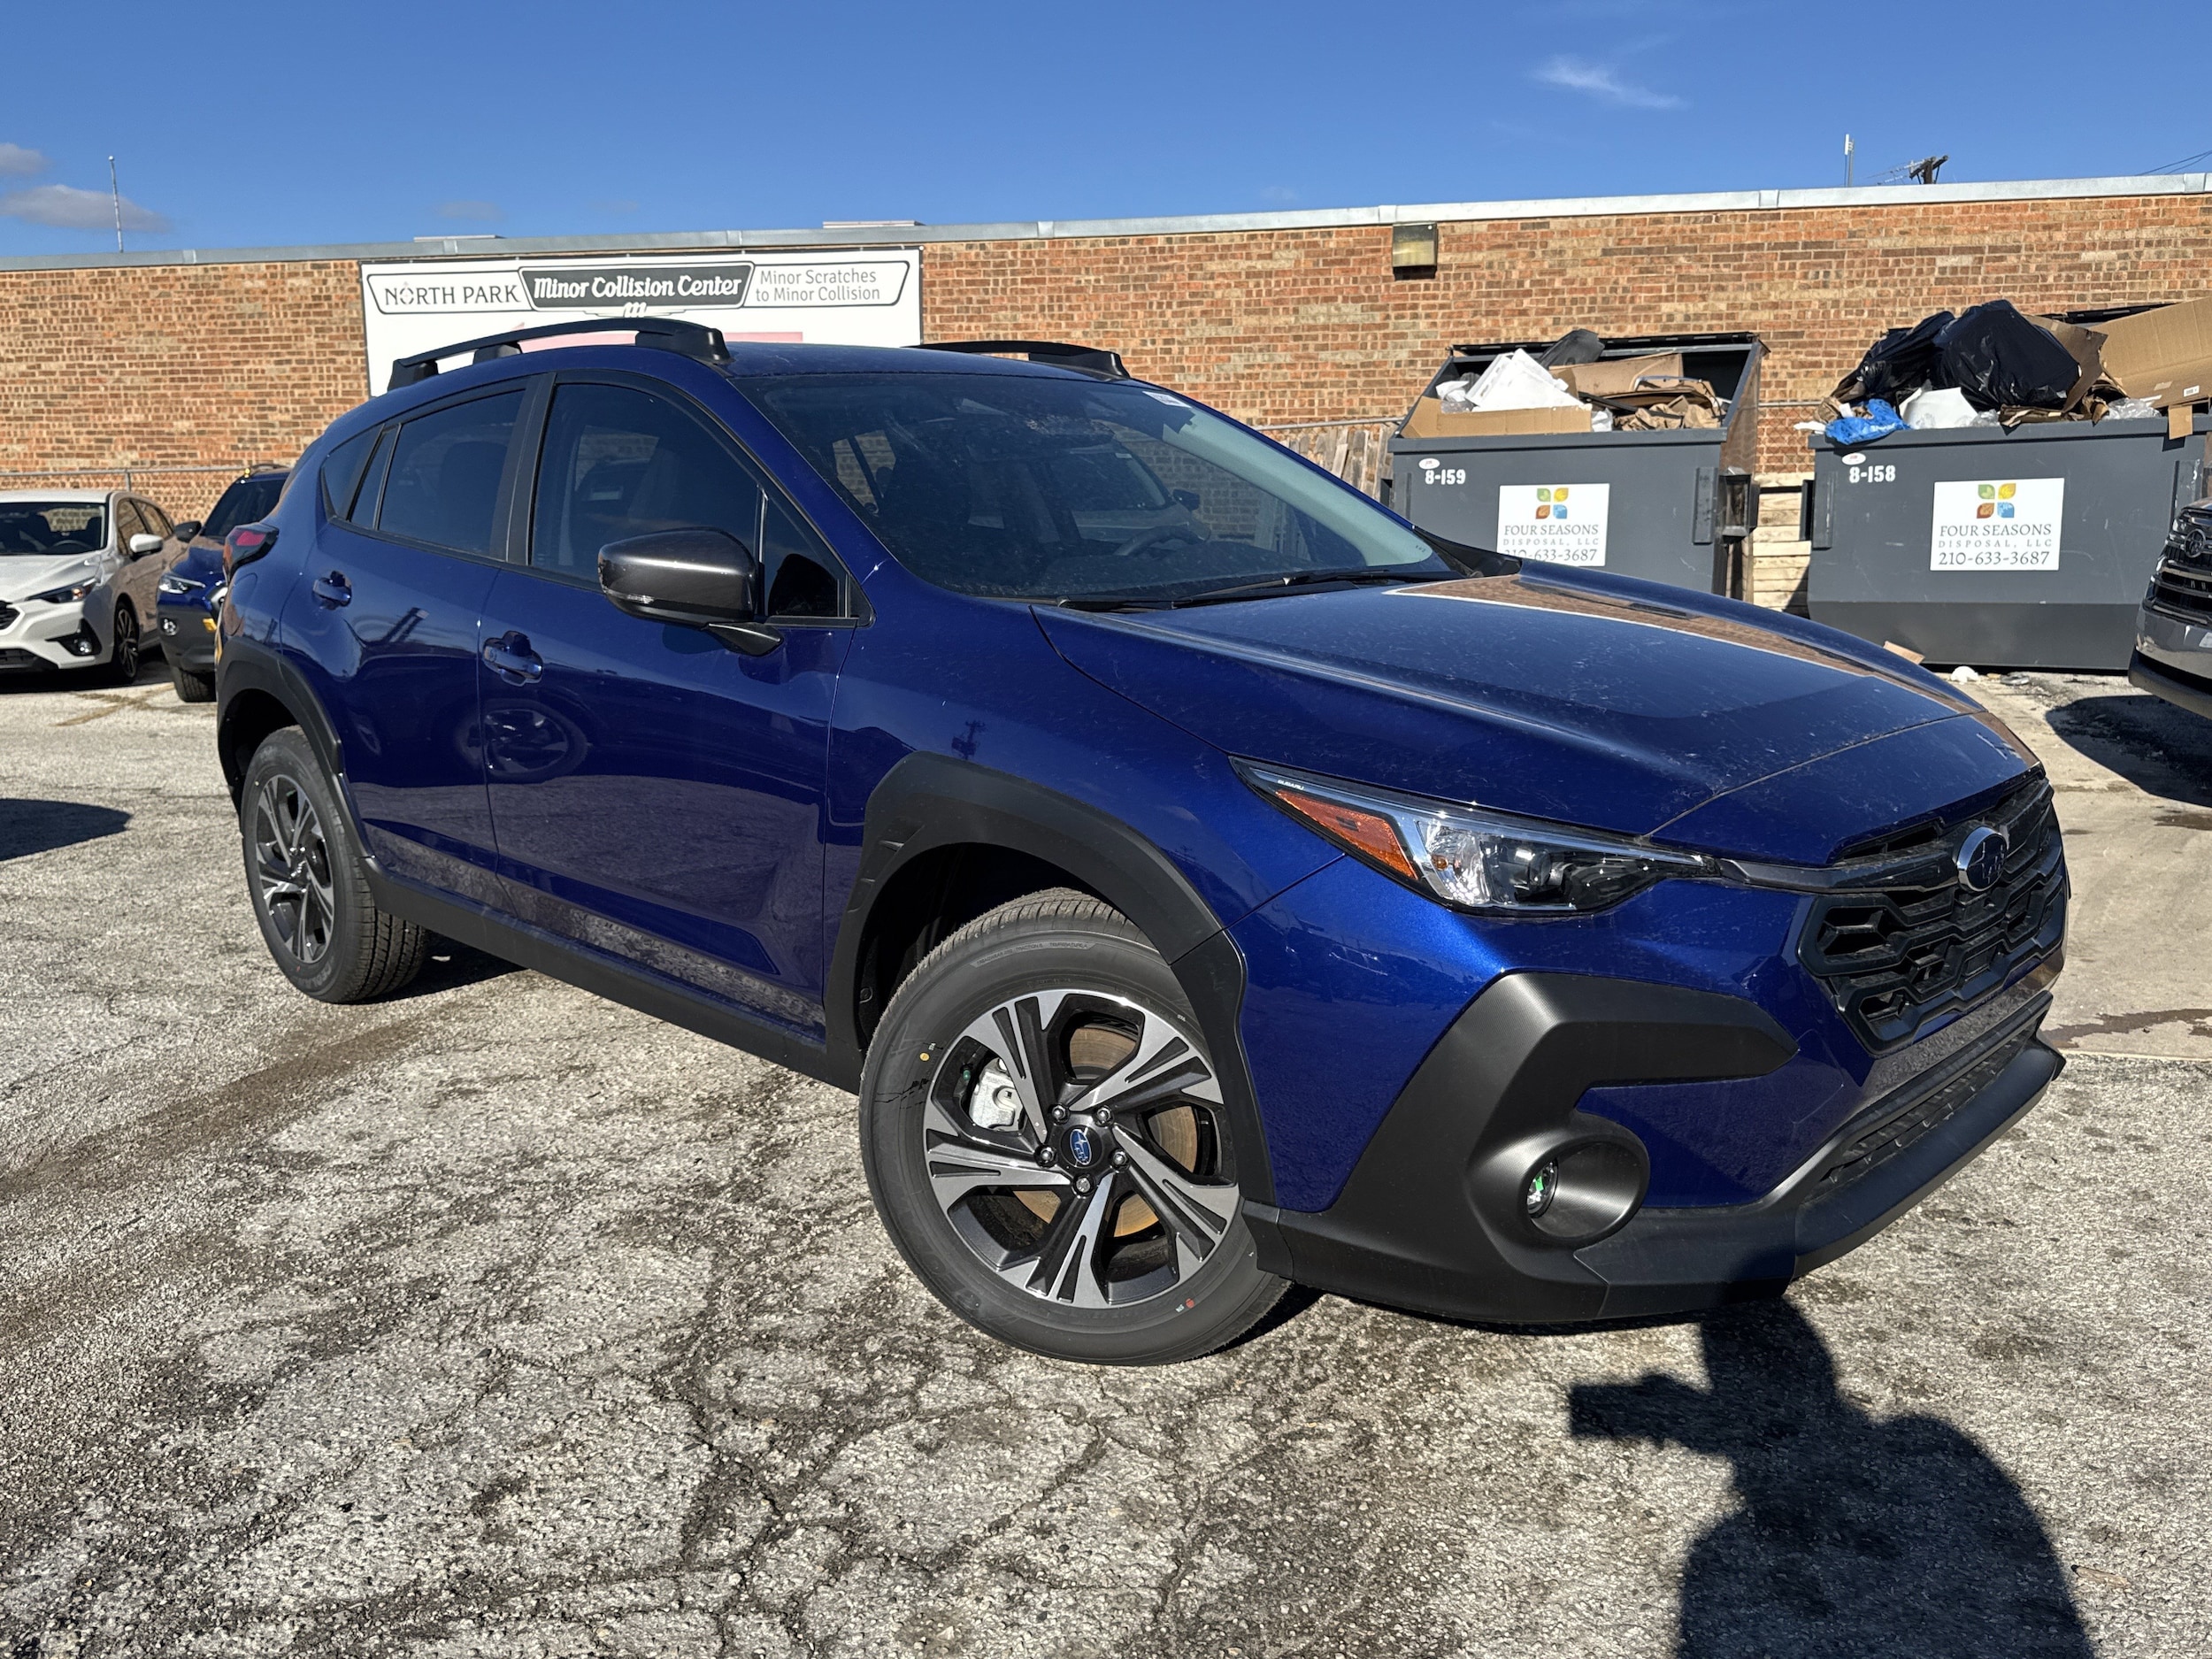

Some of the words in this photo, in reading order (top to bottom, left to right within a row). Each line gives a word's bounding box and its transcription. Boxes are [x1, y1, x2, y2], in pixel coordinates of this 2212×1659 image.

[760, 270, 802, 285] Minor
[805, 268, 877, 284] Scratches
[534, 276, 589, 298] Minor
[591, 274, 675, 298] Collision
[678, 274, 742, 297] Center
[756, 287, 770, 302] to
[773, 287, 815, 302] Minor
[818, 285, 879, 301] Collision
[385, 285, 455, 305] NORTH
[464, 284, 521, 304] PARK
[1425, 469, 1466, 485] 8-159
[1848, 465, 1896, 483] 8-158
[1504, 525, 1538, 535] FOUR
[1540, 524, 1599, 535] SEASONS
[1939, 525, 1978, 536] FOUR
[1982, 523, 2052, 536] SEASONS
[1938, 539, 2016, 548] DISPOSAL,
[1939, 551, 2050, 565] 210-633-3687
